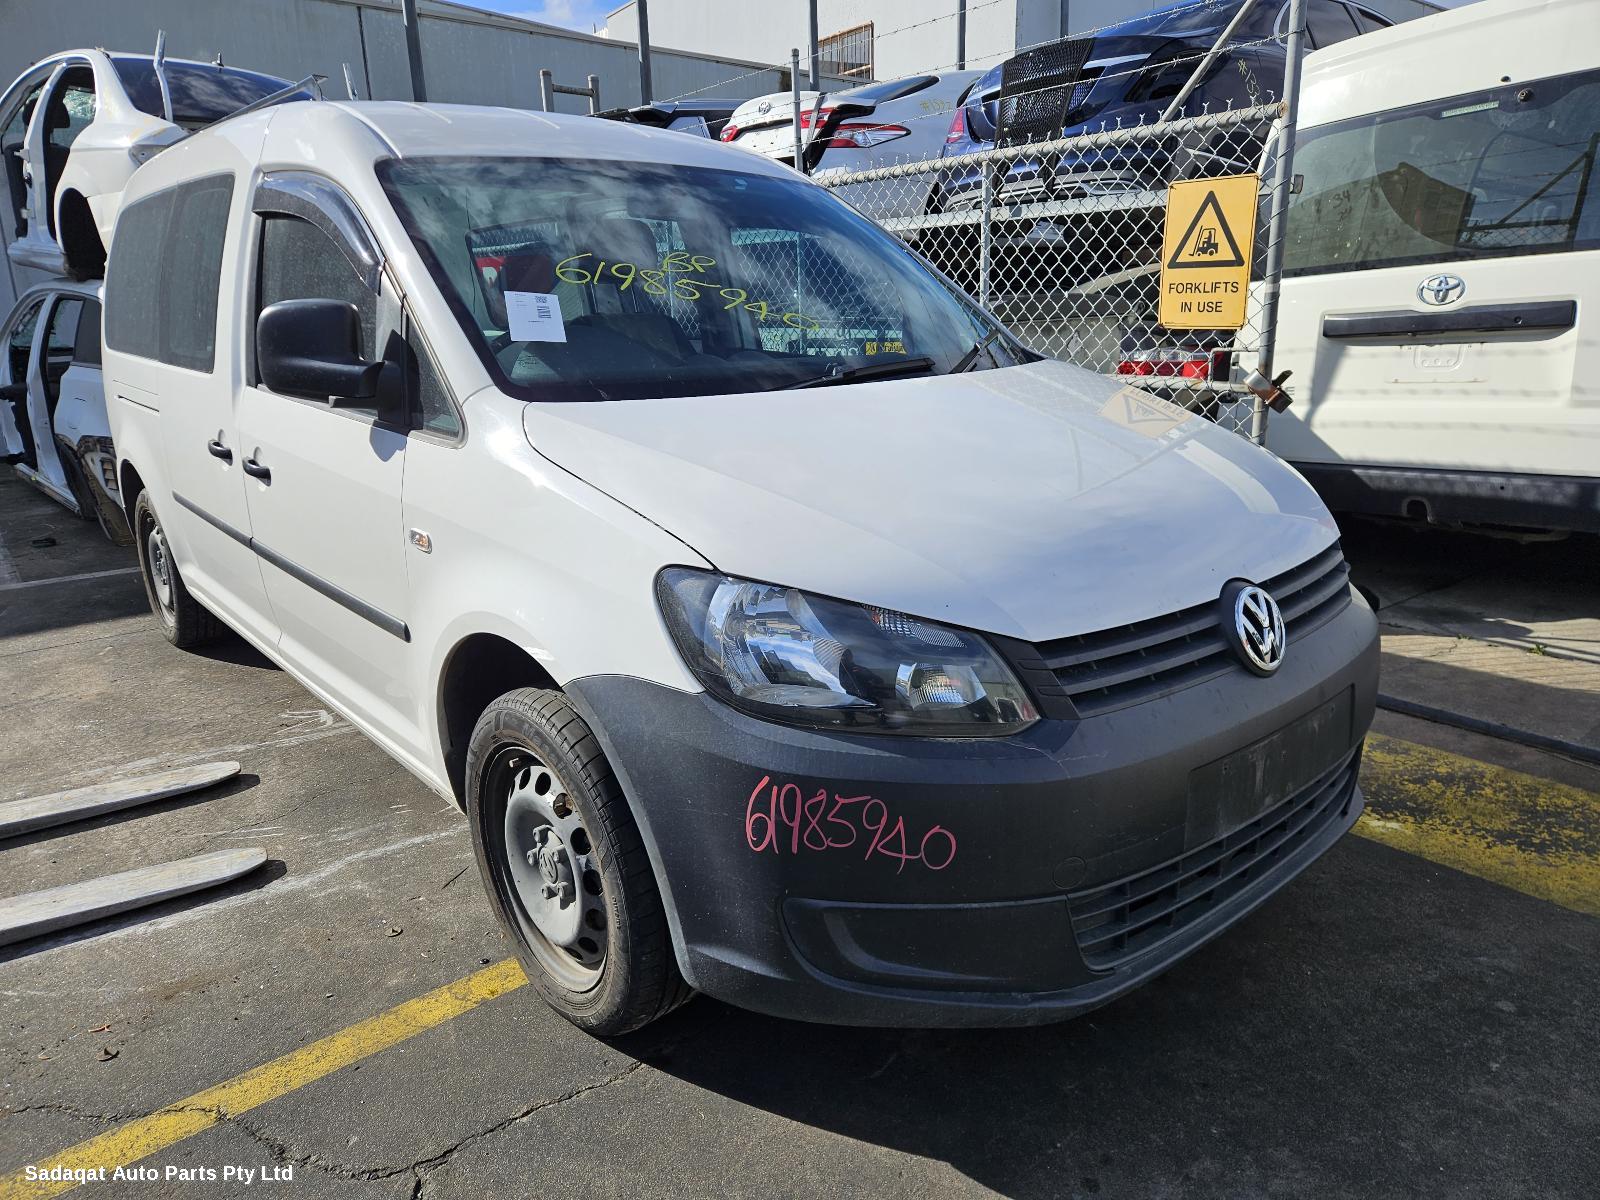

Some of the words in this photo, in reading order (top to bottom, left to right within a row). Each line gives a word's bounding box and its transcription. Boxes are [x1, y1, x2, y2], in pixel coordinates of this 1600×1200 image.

[555, 252, 820, 331] 61985940
[1168, 281, 1239, 294] FORKLIFTS
[1180, 301, 1193, 313] IN
[1197, 301, 1223, 313] USE
[745, 775, 957, 874] 61985940
